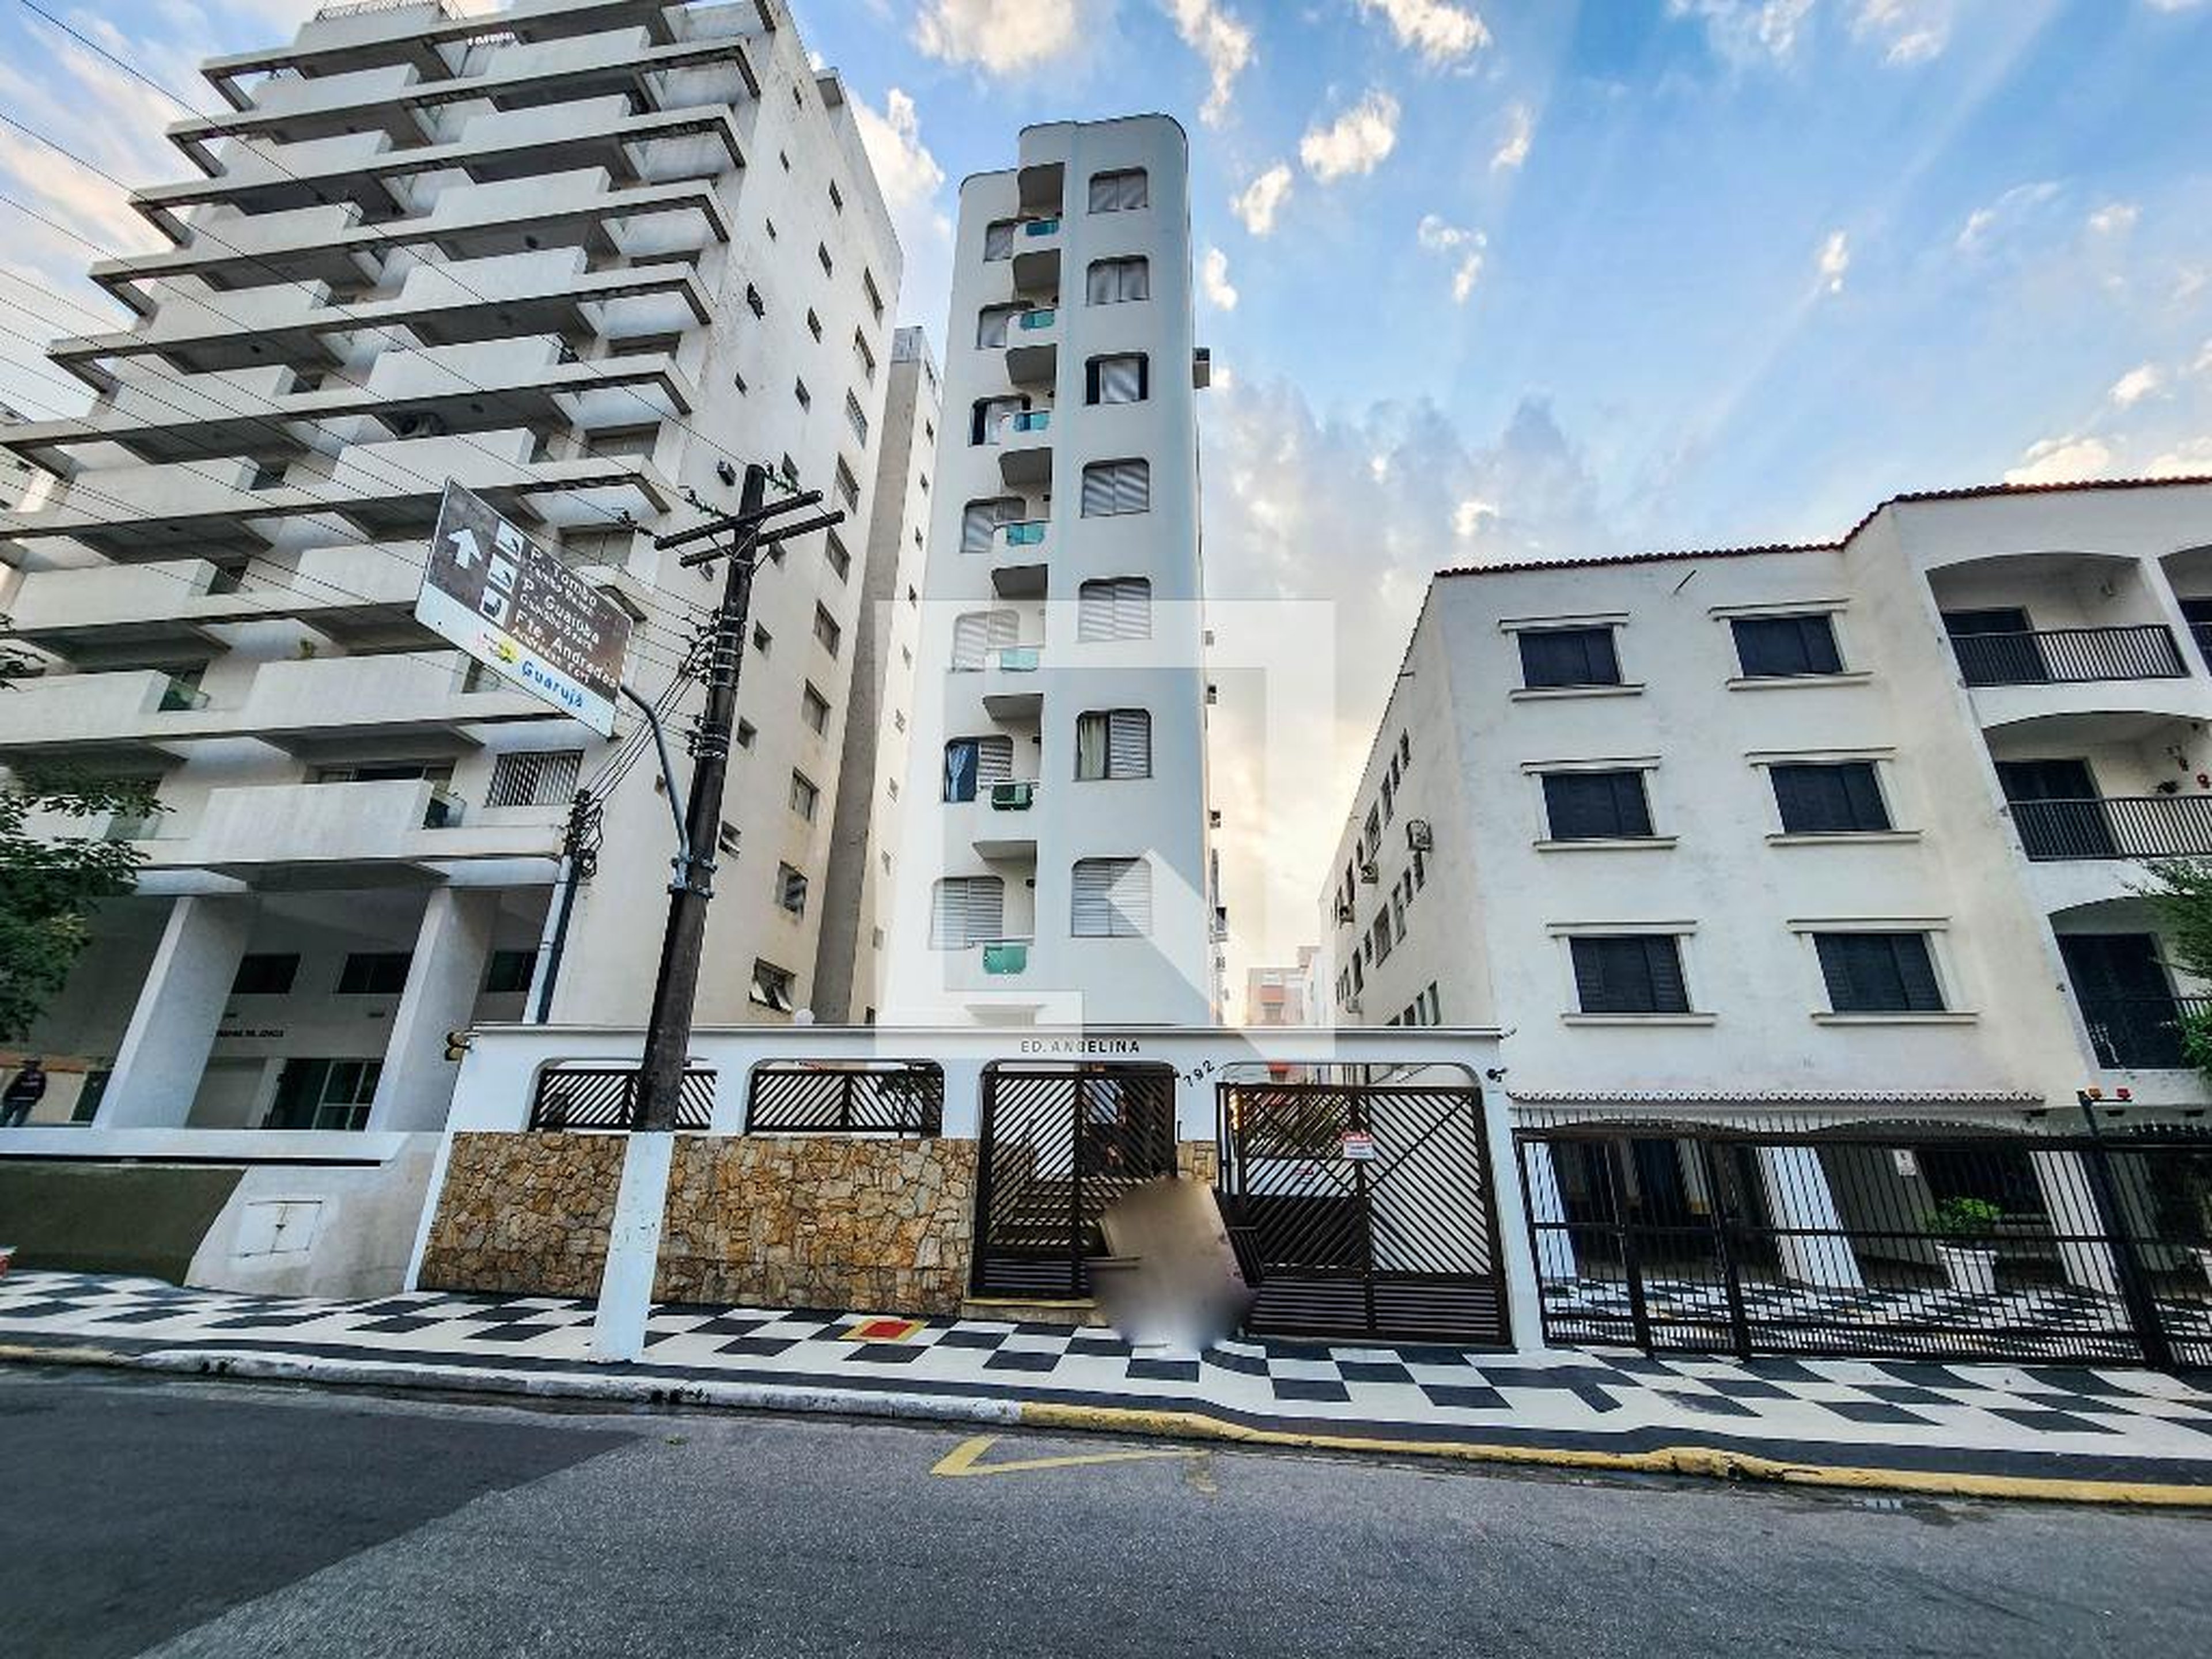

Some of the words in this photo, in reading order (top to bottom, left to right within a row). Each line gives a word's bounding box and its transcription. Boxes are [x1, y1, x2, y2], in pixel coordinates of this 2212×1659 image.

[552, 561, 597, 607] Tombo
[521, 660, 584, 707] Guarujá
[1020, 1040, 1047, 1053] ED.
[1050, 1040, 1140, 1053] ANGELINA
[1183, 1059, 1215, 1088] 792
